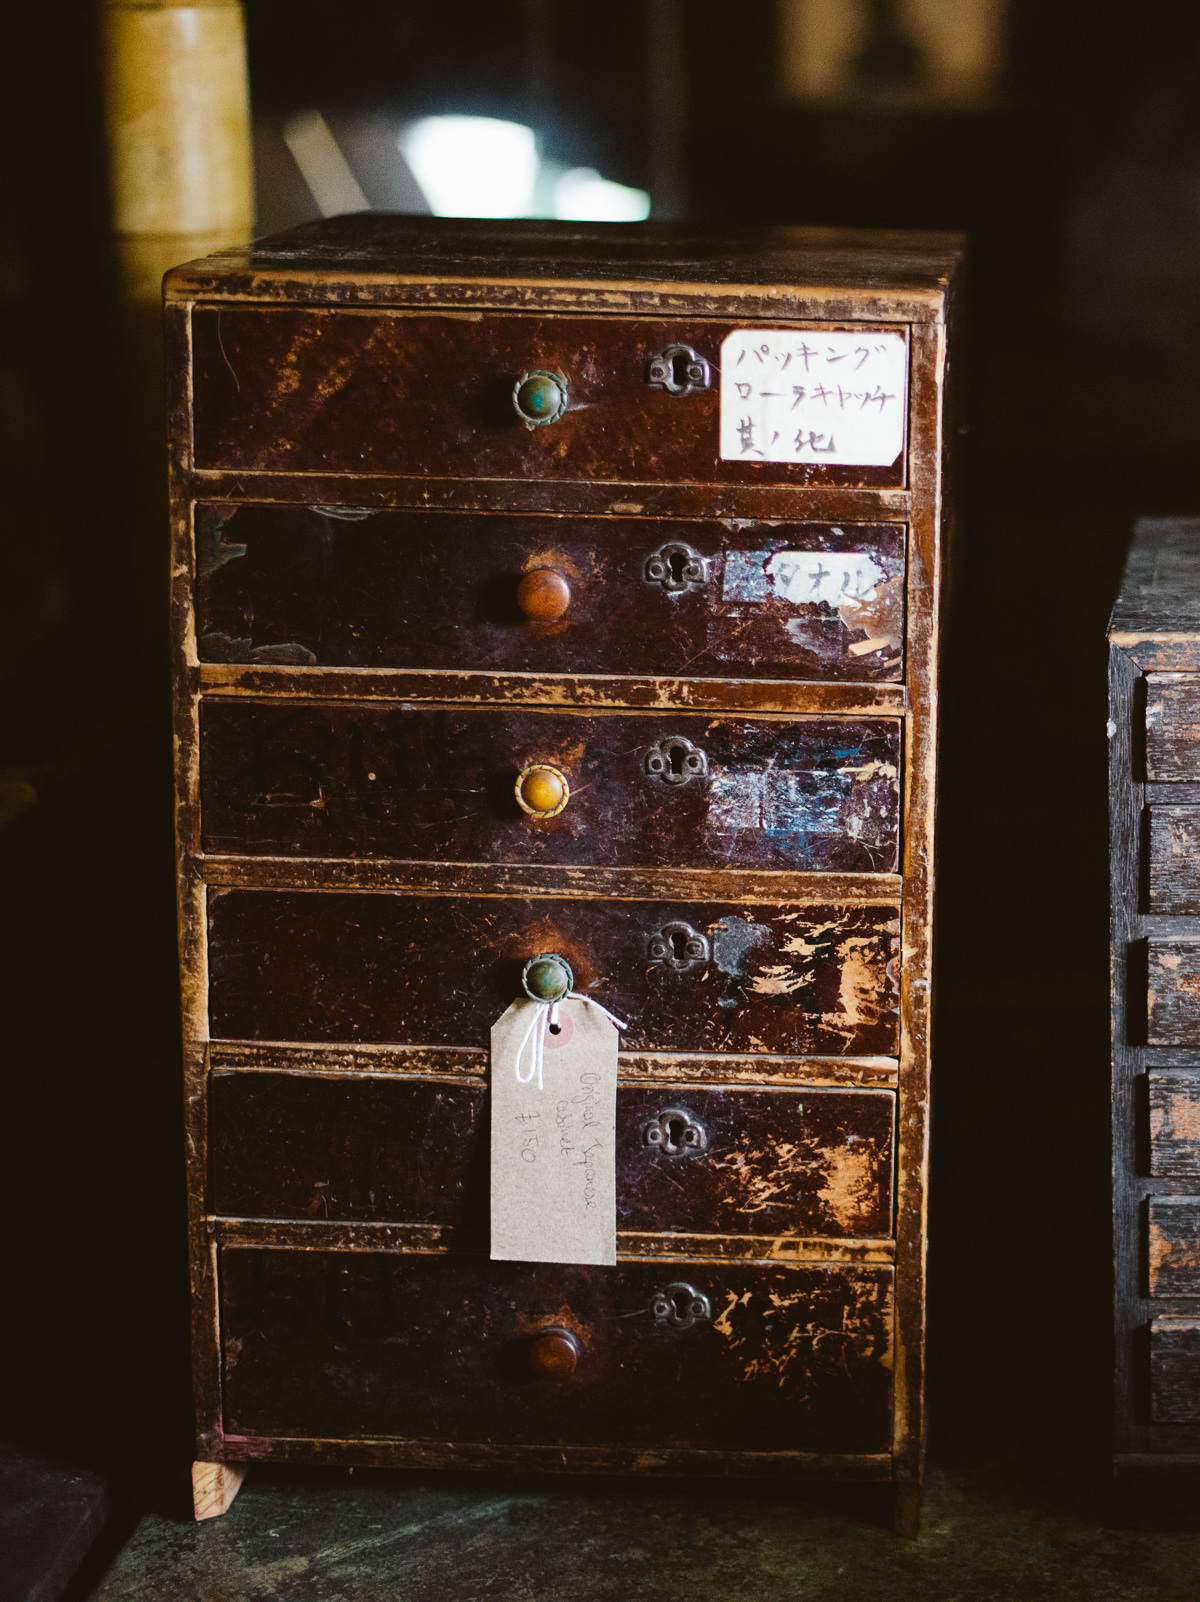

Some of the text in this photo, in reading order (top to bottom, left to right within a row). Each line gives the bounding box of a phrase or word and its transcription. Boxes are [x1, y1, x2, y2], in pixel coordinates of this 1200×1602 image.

[735, 341, 887, 372] パッキング
[515, 1112, 541, 1163] £150
[571, 1073, 603, 1211] Original Japanese
